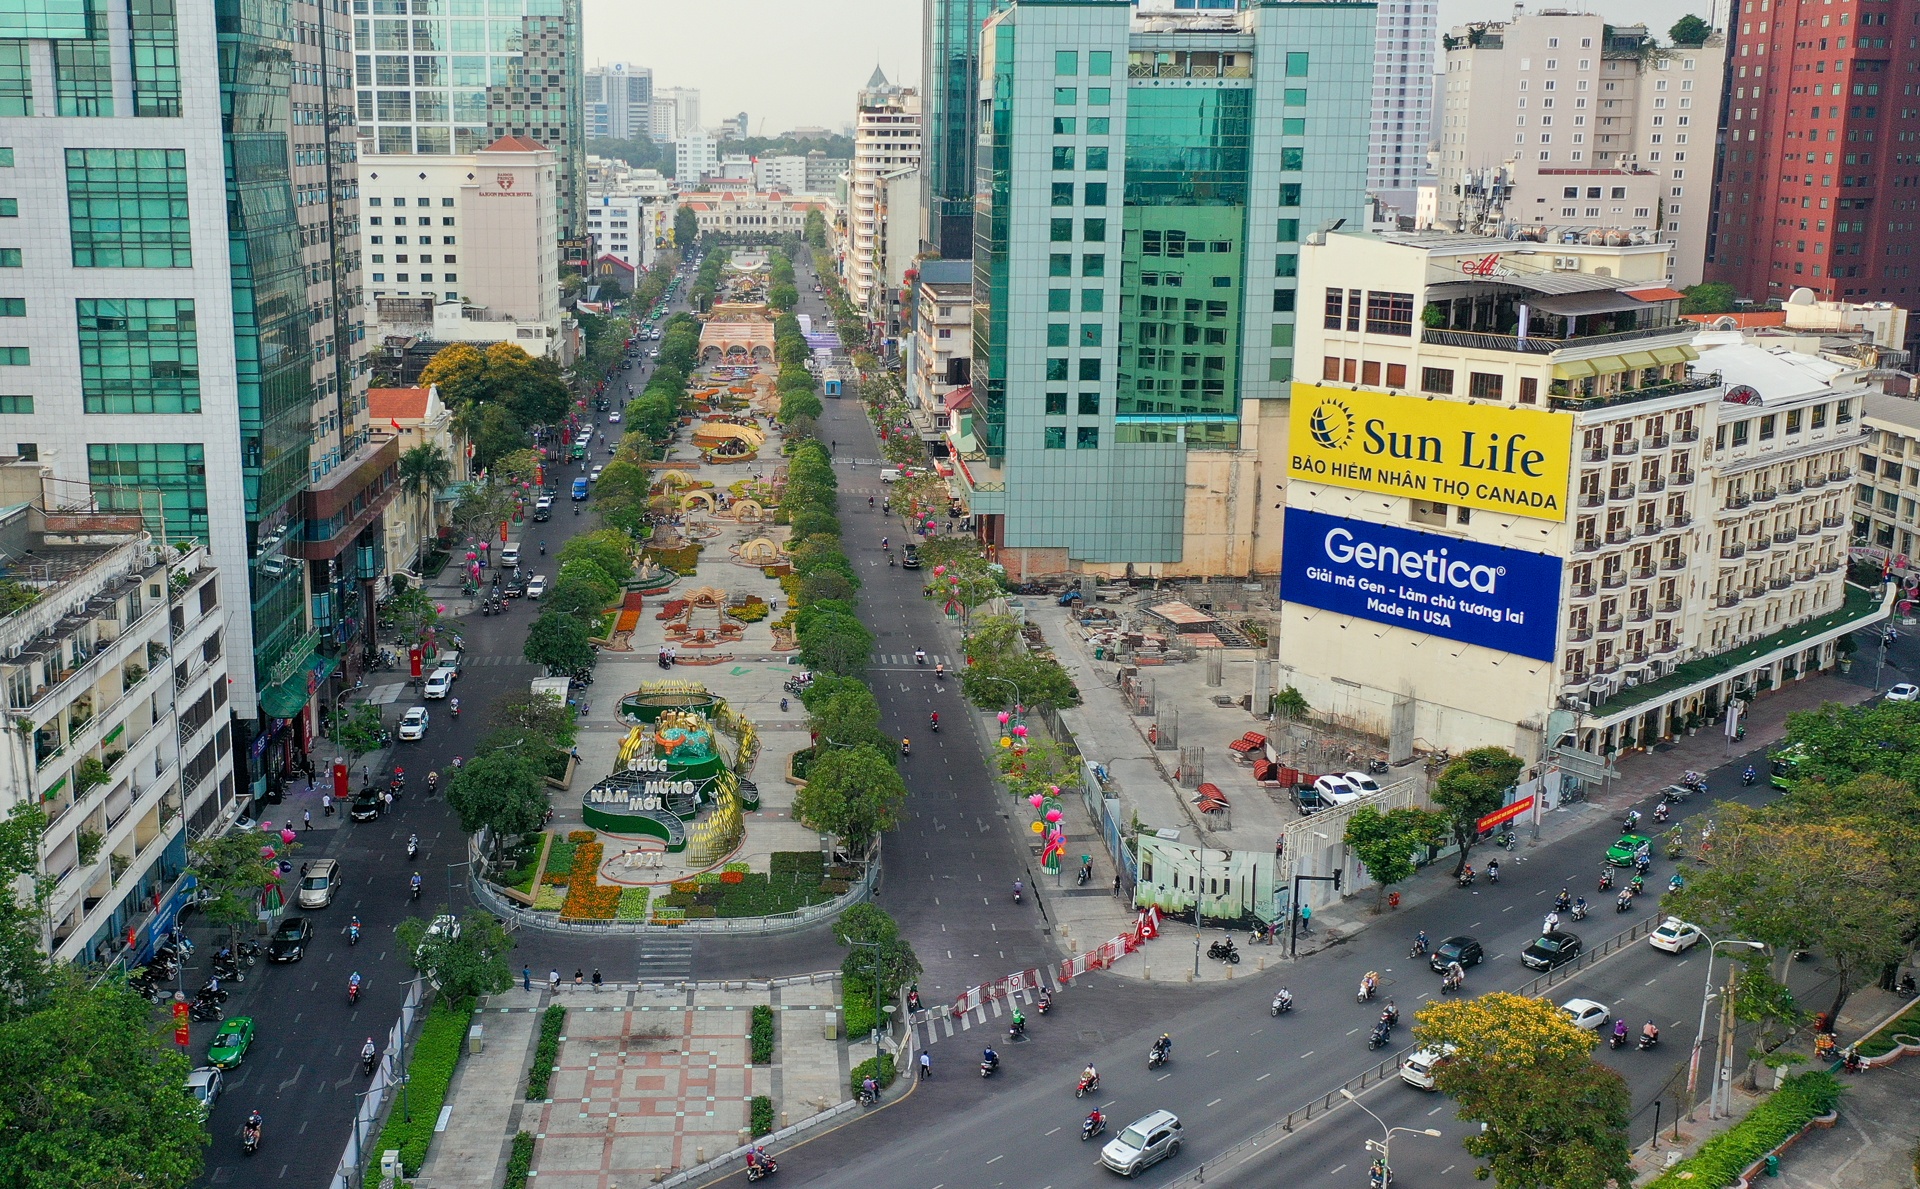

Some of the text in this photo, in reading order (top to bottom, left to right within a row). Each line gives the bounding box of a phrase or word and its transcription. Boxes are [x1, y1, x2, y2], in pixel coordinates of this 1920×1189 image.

[1363, 418, 1545, 478] Sun Life
[1292, 455, 1557, 511] BẢO HIỂM NHÂN THỌ CANADA
[1306, 567, 1332, 584] Giải
[1335, 575, 1355, 588] mã
[1358, 579, 1385, 594] Gen
[1399, 586, 1427, 604] Làm
[1431, 594, 1456, 611] chủ
[1459, 600, 1502, 622] tương
[1506, 608, 1524, 624] lai
[1367, 597, 1452, 628] Made in USA
[627, 757, 667, 771] CHÚC
[629, 795, 662, 811] MỚI
[623, 852, 663, 867] 2021
